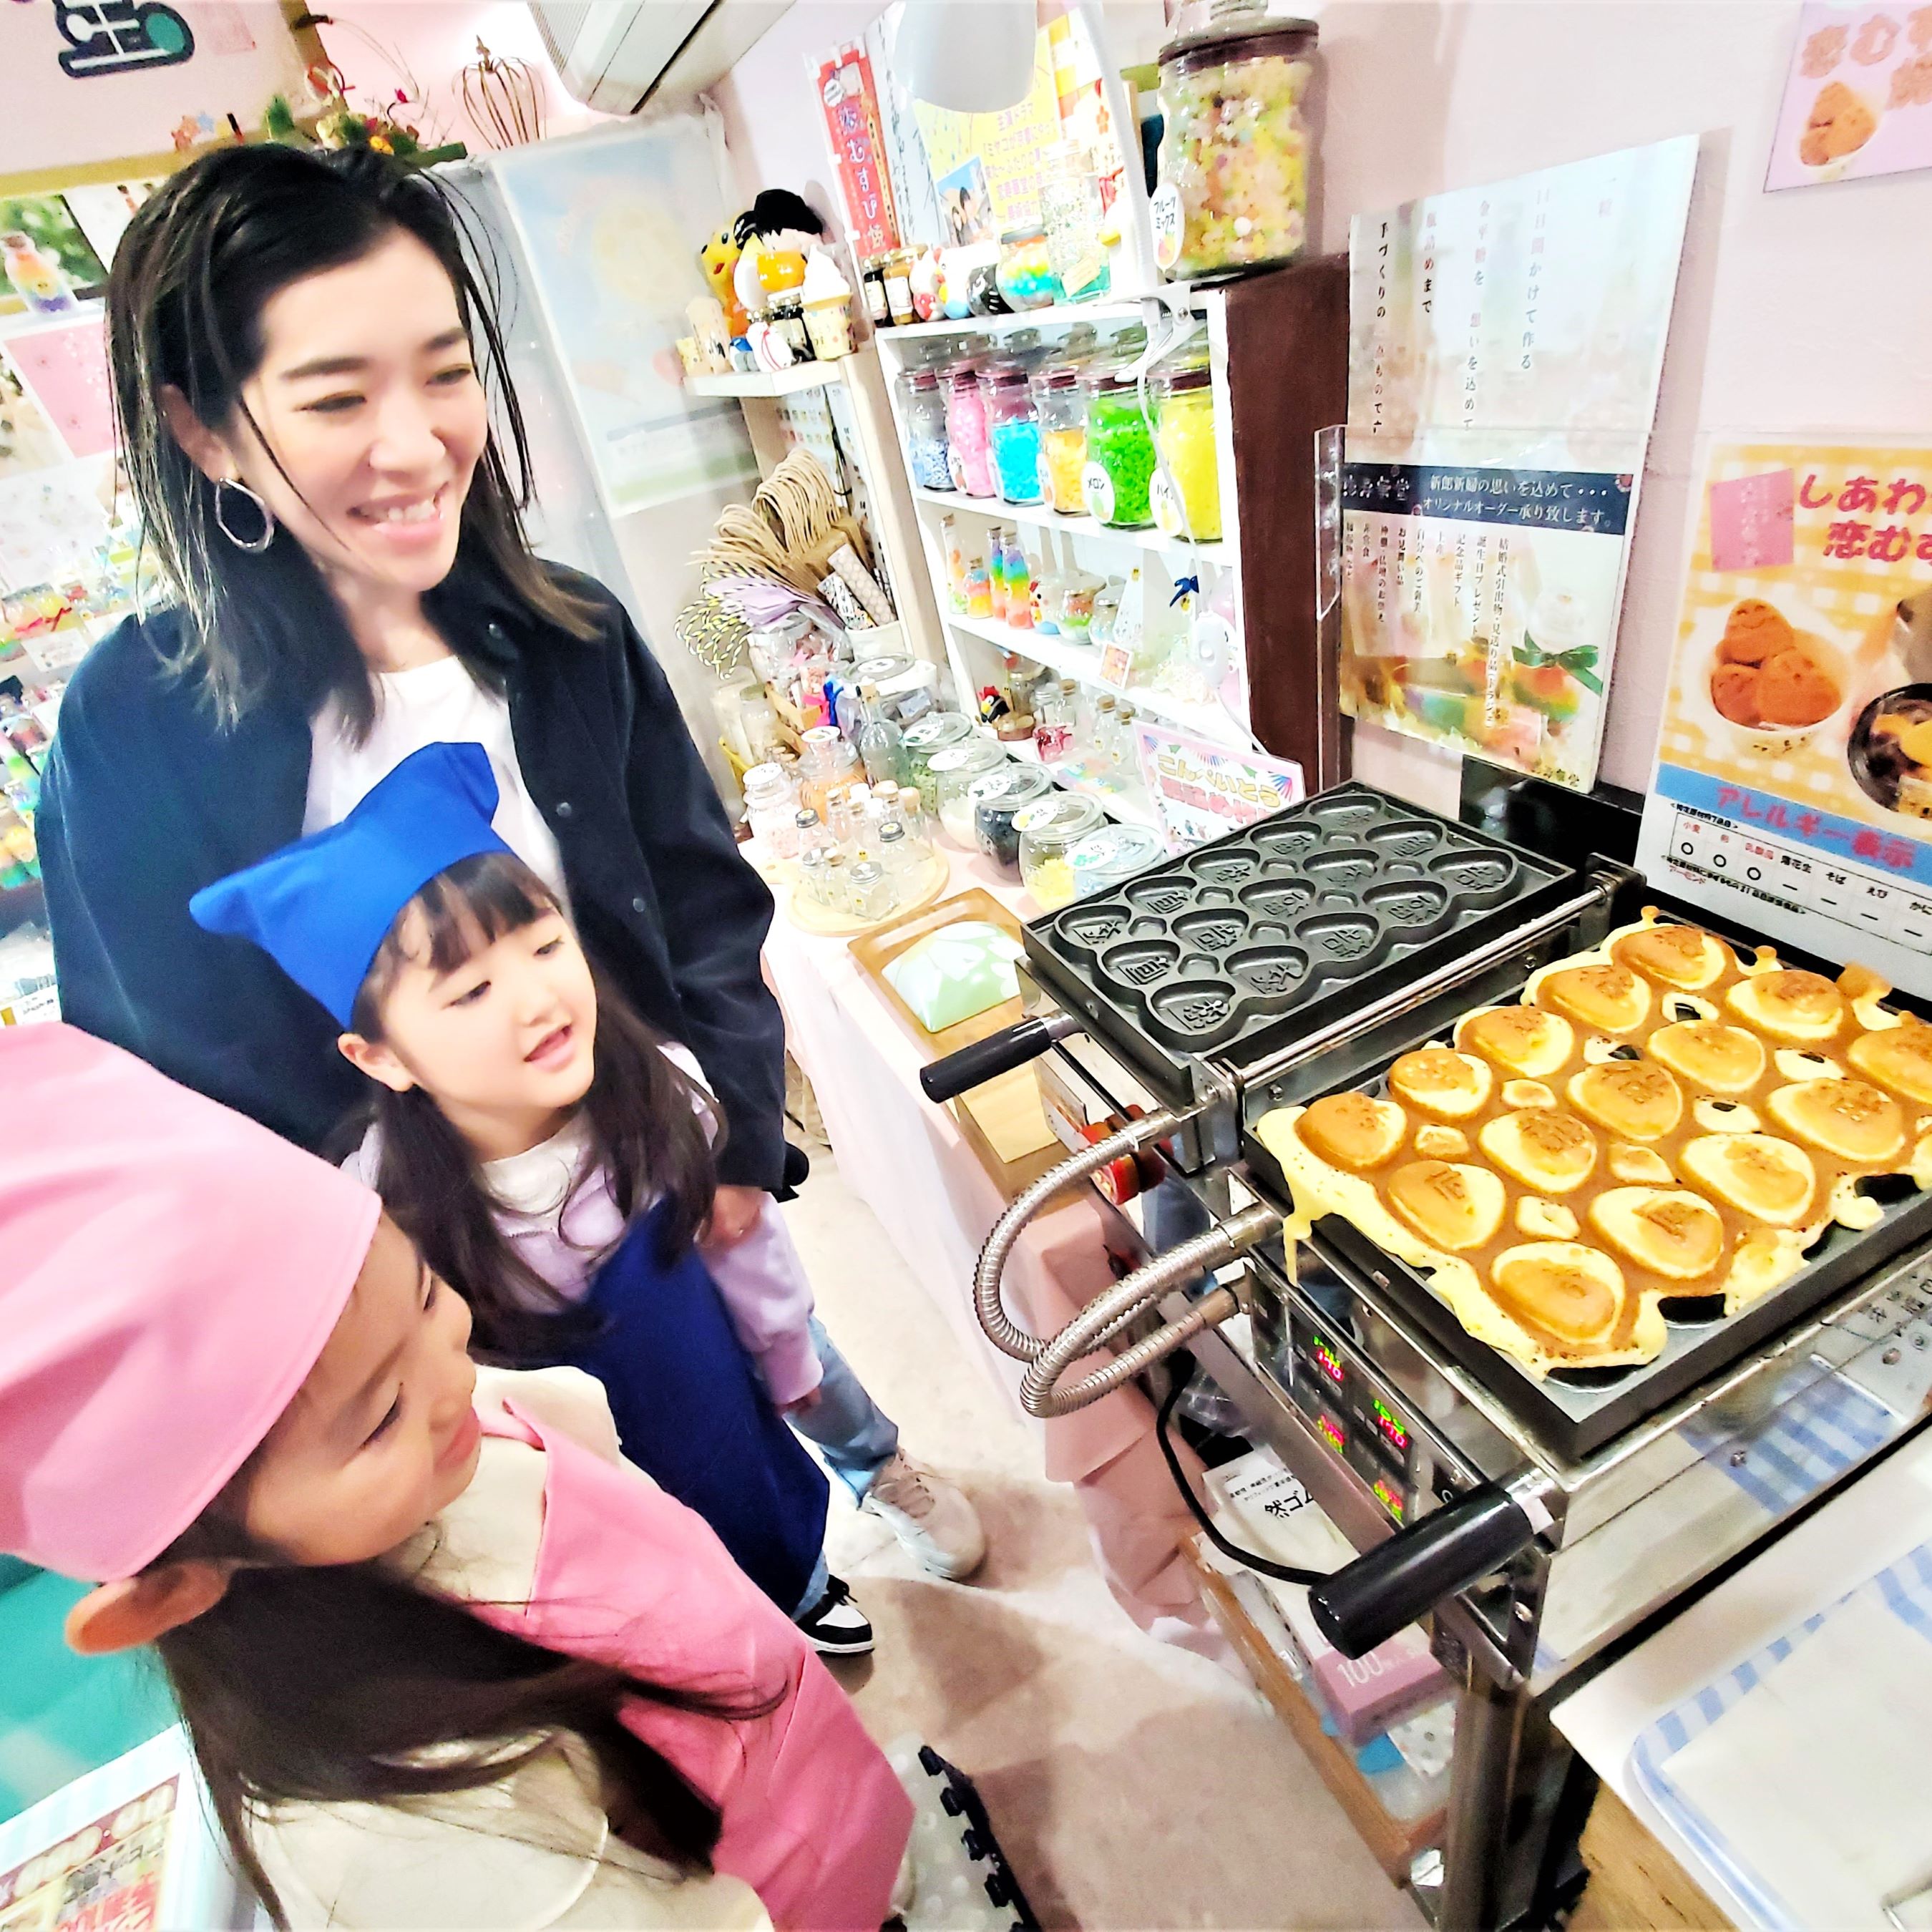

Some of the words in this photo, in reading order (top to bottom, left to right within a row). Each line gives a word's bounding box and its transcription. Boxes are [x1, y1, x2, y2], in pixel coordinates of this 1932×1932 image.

[1153, 196, 1176, 213] フルーツ
[1800, 474, 1932, 515] しあわ
[1158, 753, 1281, 807] こんぺいとう
[1717, 786, 1918, 869] アレルギー表示
[1825, 871, 1847, 885] そば
[1866, 886, 1889, 899] えび
[1337, 1650, 1383, 1688] 100
